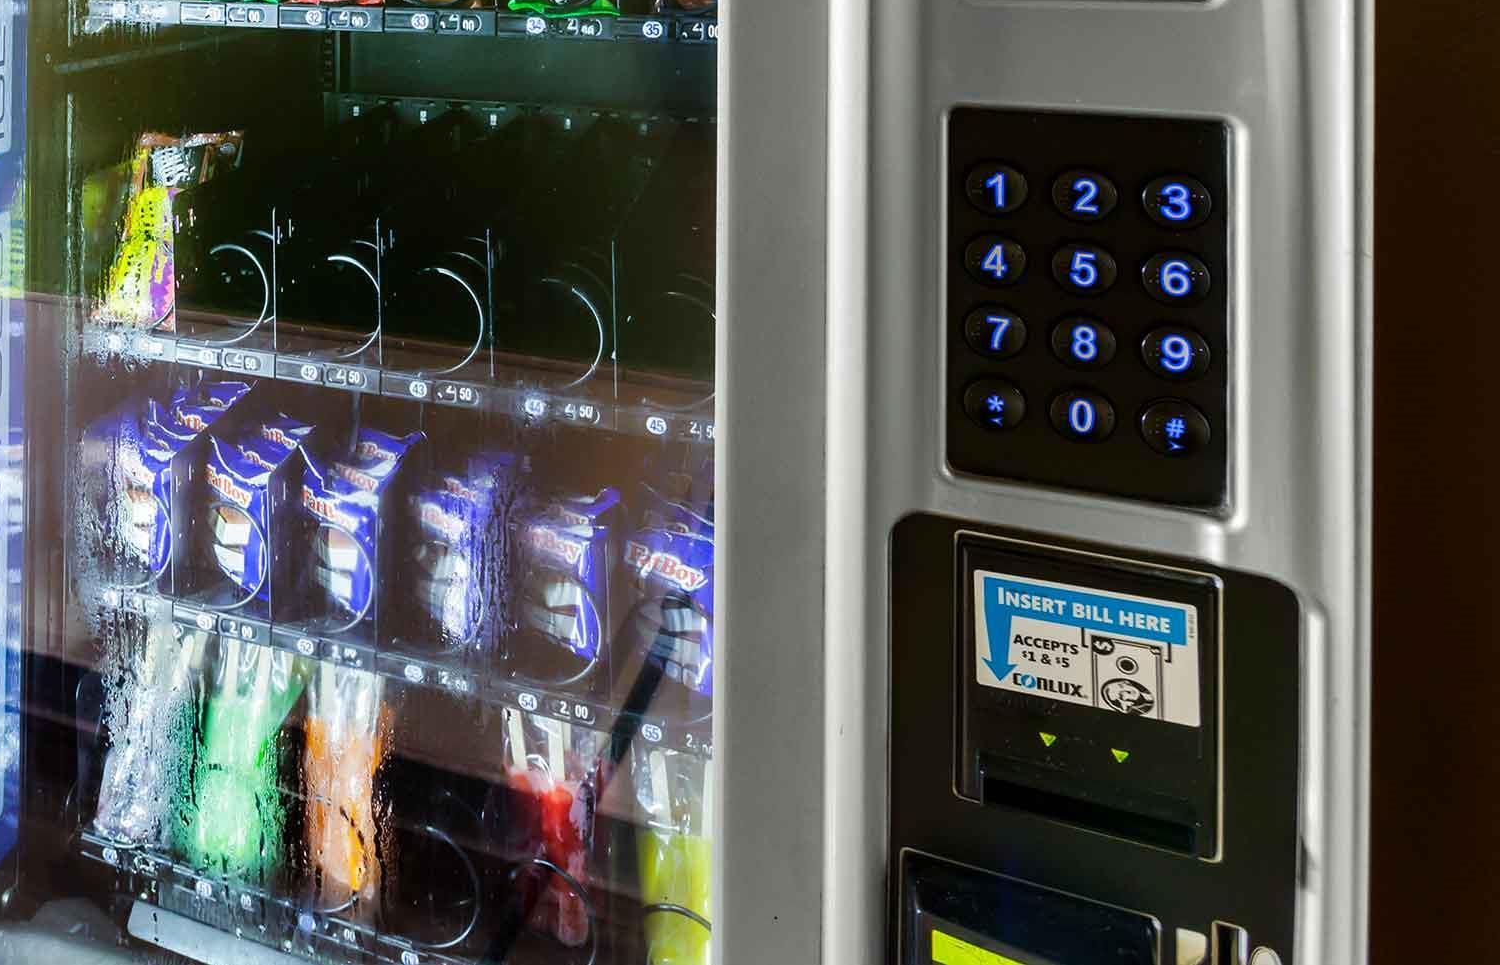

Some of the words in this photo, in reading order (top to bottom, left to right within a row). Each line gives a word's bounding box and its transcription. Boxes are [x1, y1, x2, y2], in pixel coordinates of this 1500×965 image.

[986, 172, 1005, 208] 1
[1073, 179, 1099, 214] 2
[1160, 183, 1192, 220] 3
[982, 244, 1008, 277] 4
[1069, 252, 1097, 288] 5
[1160, 260, 1192, 296] 6
[985, 316, 1010, 351] 7
[1073, 326, 1098, 361] 8
[1160, 336, 1192, 371] 9
[1069, 399, 1096, 433] 0
[1165, 418, 1186, 438] #
[625, 540, 705, 592] FatBoy
[997, 586, 1067, 616] INSERT
[1071, 602, 1114, 624] BILL
[1119, 612, 1171, 634] HERE
[1013, 634, 1080, 655] ACCEPTS
[1022, 650, 1037, 663] $1
[1040, 653, 1052, 666] &
[1055, 656, 1070, 668] $5
